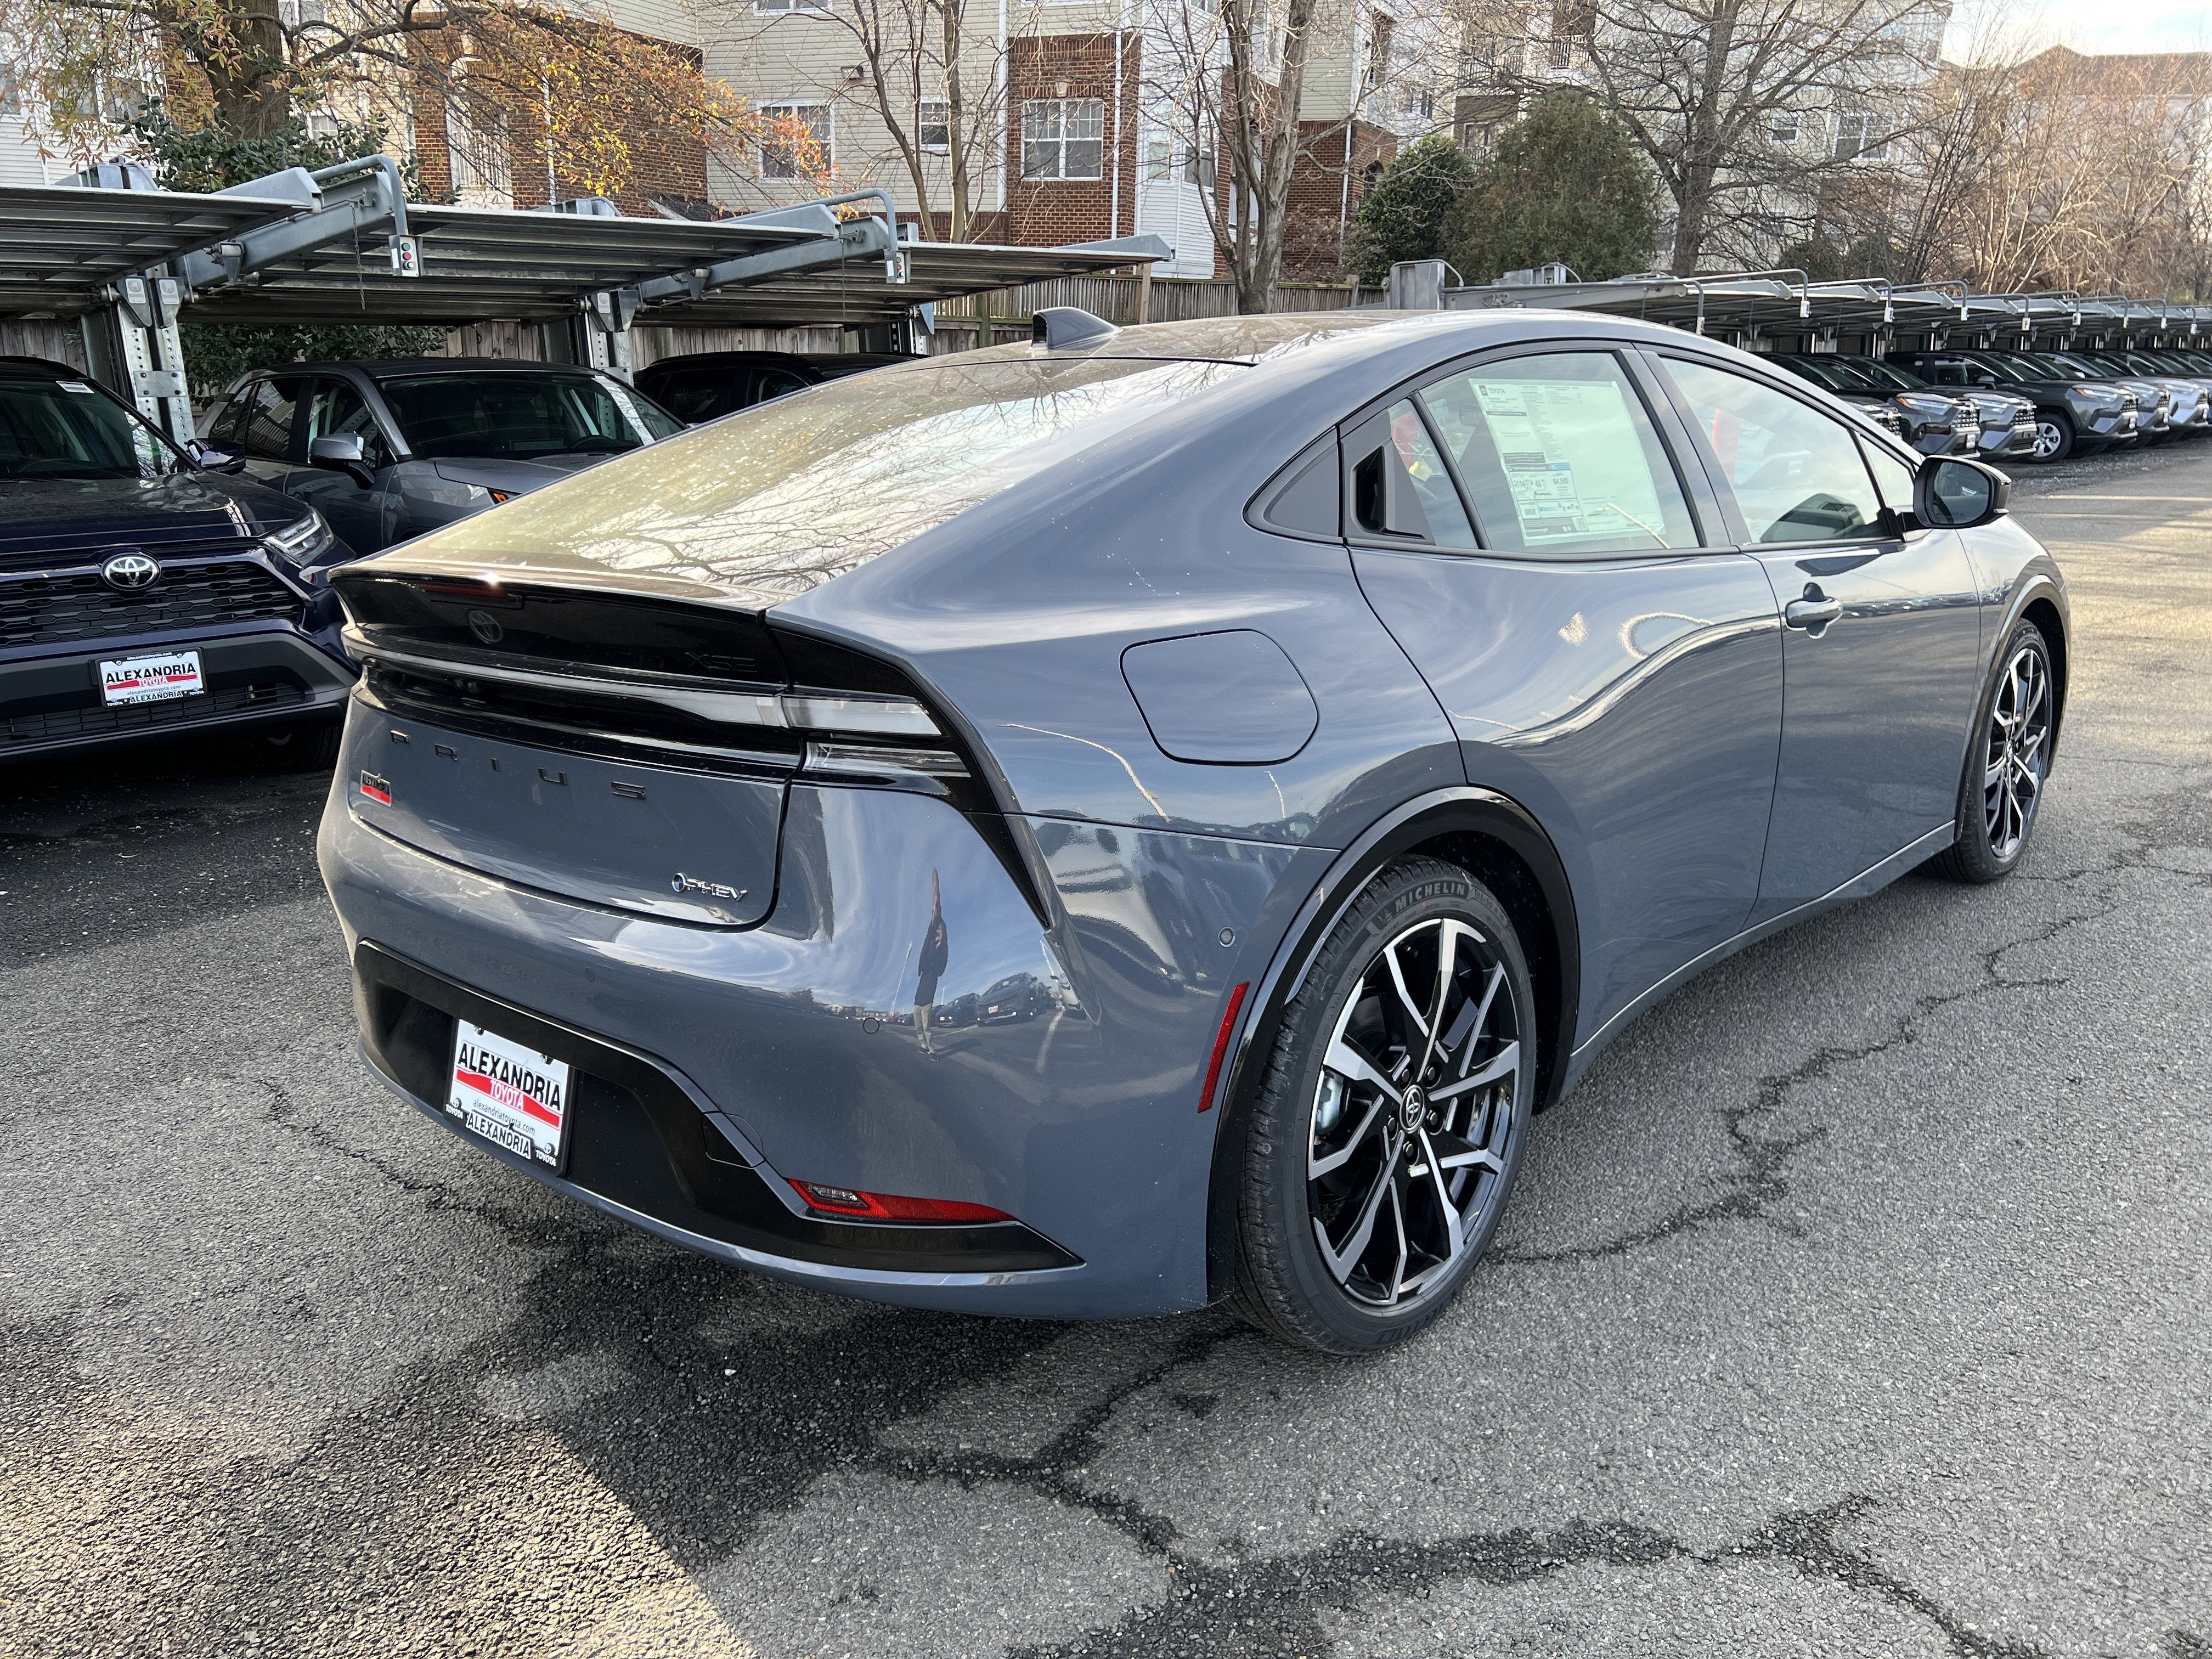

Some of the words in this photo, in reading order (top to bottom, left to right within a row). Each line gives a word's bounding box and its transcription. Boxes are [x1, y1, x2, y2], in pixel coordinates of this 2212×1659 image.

[106, 663, 196, 684] ALEXANDRIA
[685, 652, 758, 673] XSE
[138, 676, 168, 686] TOYOTA
[130, 691, 182, 703] ALEXANDRIA
[391, 730, 646, 799] PRIUS
[1394, 883, 1465, 912] MICHELIN
[458, 1042, 561, 1111] ALEXANDRIA
[490, 1080, 524, 1110] TOYOTA
[473, 1099, 535, 1136] alexandriatoyota.com
[445, 1104, 463, 1119] TOYOTA
[467, 1113, 531, 1159] ALEXANDRIA
[535, 1149, 556, 1167] TOYOTA
